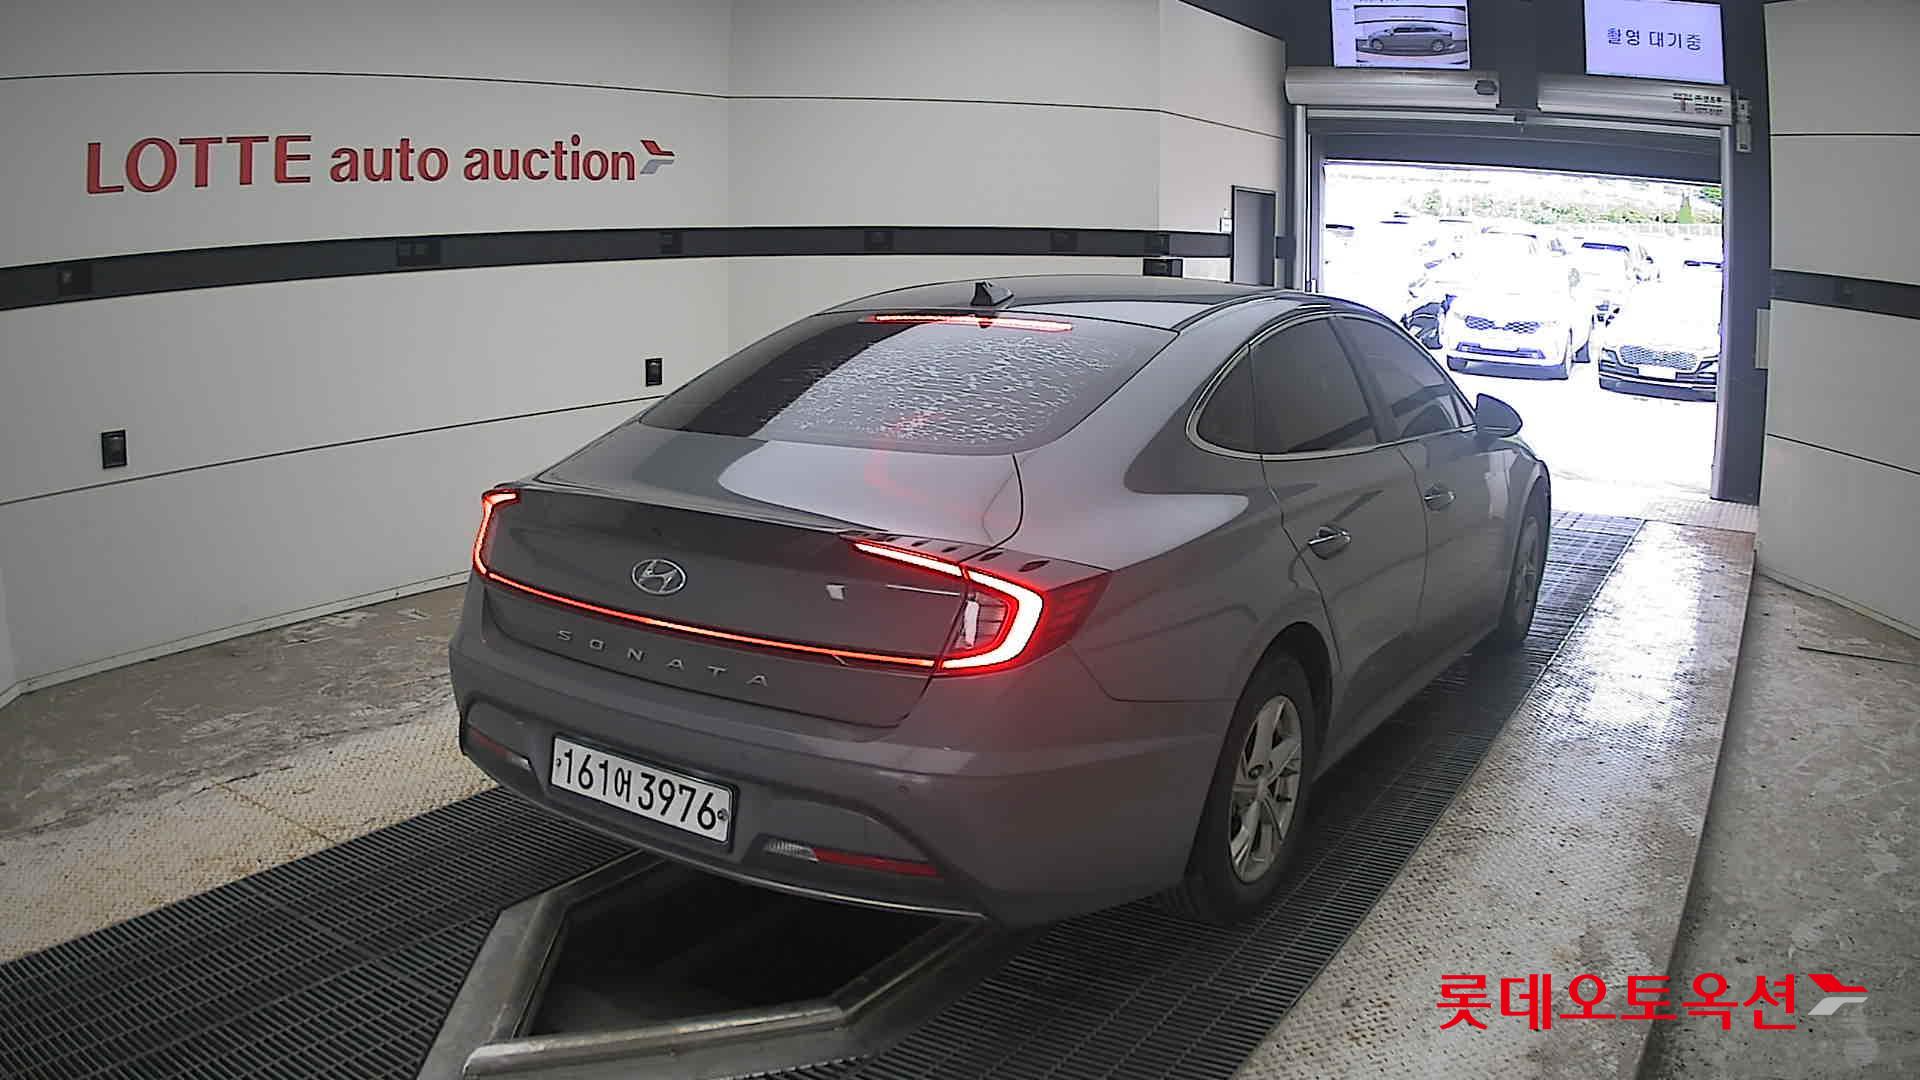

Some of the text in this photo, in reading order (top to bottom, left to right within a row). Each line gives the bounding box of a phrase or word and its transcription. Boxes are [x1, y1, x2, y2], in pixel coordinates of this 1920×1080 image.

[87, 134, 637, 194] LOTTE auto auction
[557, 630, 768, 687] SONATA
